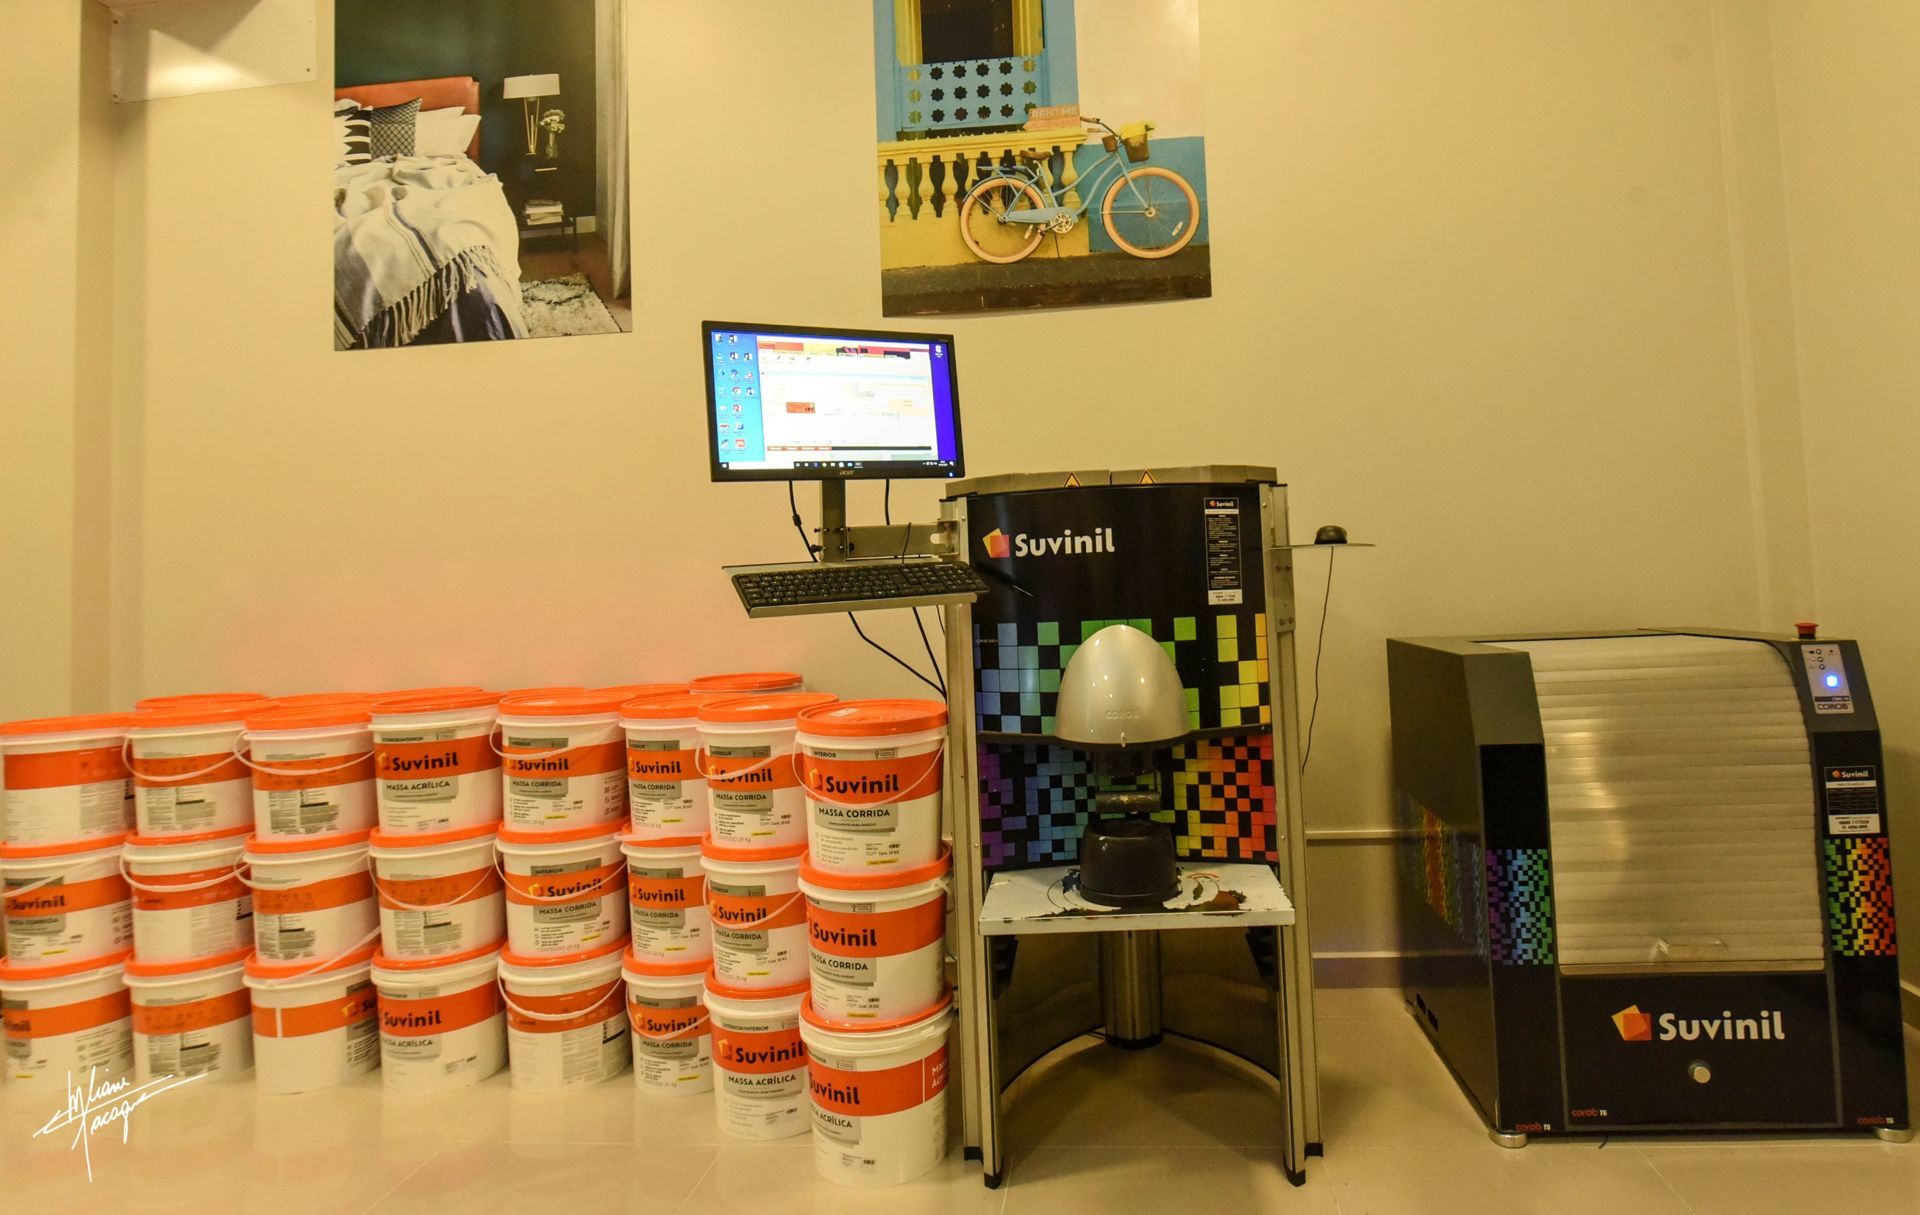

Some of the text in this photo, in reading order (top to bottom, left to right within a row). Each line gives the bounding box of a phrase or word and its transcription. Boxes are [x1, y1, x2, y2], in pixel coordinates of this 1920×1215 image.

[1015, 527, 1115, 557] Suvinil
[392, 751, 458, 771] Suvinil
[517, 758, 569, 771] Suvinil
[635, 761, 682, 774] Suvinil
[1841, 770, 1869, 778] Suvinil
[386, 780, 450, 791] MASSA ACRÍLICA
[647, 783, 676, 791] CORRIDA
[825, 774, 899, 794] Suvinil
[818, 807, 890, 818] MASSA CORRIDA
[638, 888, 685, 902] Suvinil
[538, 901, 597, 915] MASSA CORRIDA
[731, 931, 762, 940] CORRIDA
[813, 922, 878, 947] Suvinil
[828, 959, 869, 971] CORRIDA
[383, 1009, 442, 1028] Suvinil
[1658, 1010, 1786, 1041] Suvinil
[397, 1039, 433, 1047] ACRÍLICA
[735, 1040, 805, 1064] Suvinil
[728, 1073, 797, 1086] MASSA ACRÍLICA
[819, 1113, 853, 1129] ACRÍLICA
